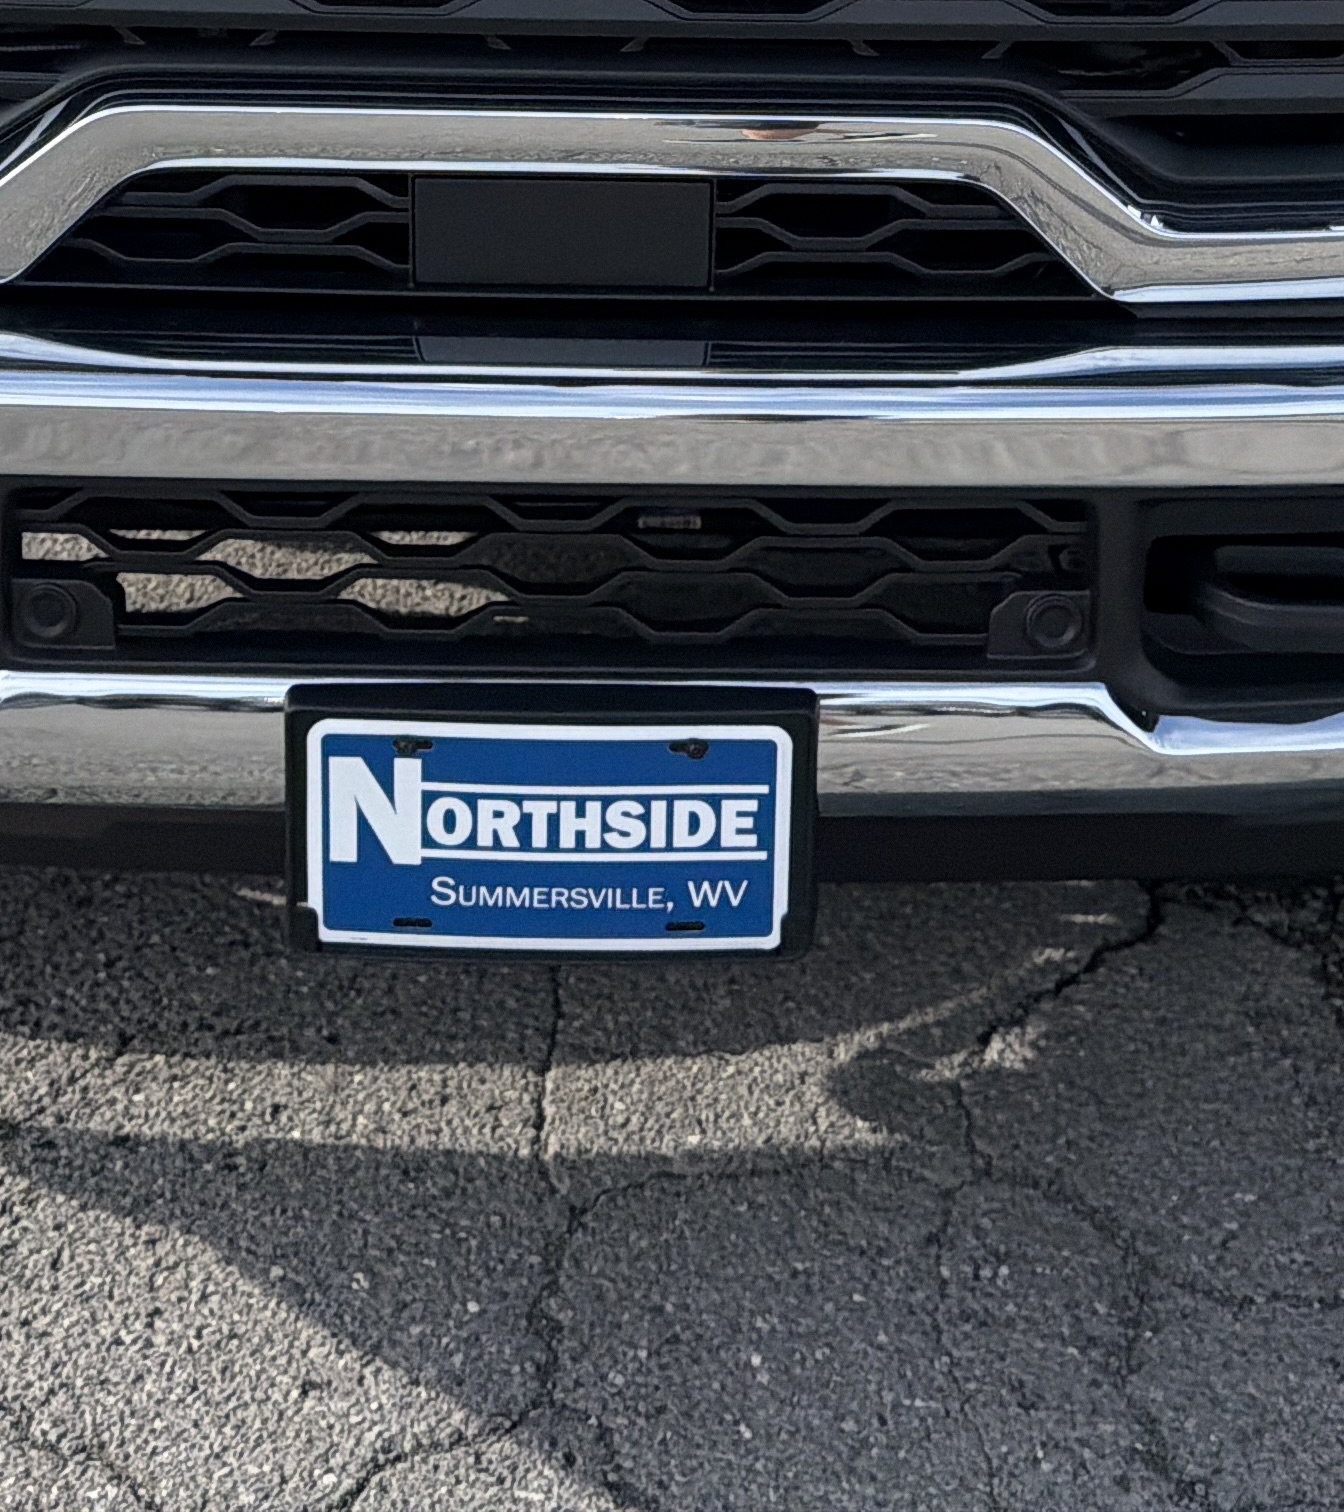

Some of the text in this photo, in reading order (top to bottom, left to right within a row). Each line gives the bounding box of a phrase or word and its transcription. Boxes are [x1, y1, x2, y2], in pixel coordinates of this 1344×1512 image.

[327, 755, 759, 865] NORTHSIDE
[430, 876, 749, 913] SUMMERSVILLE, WV
